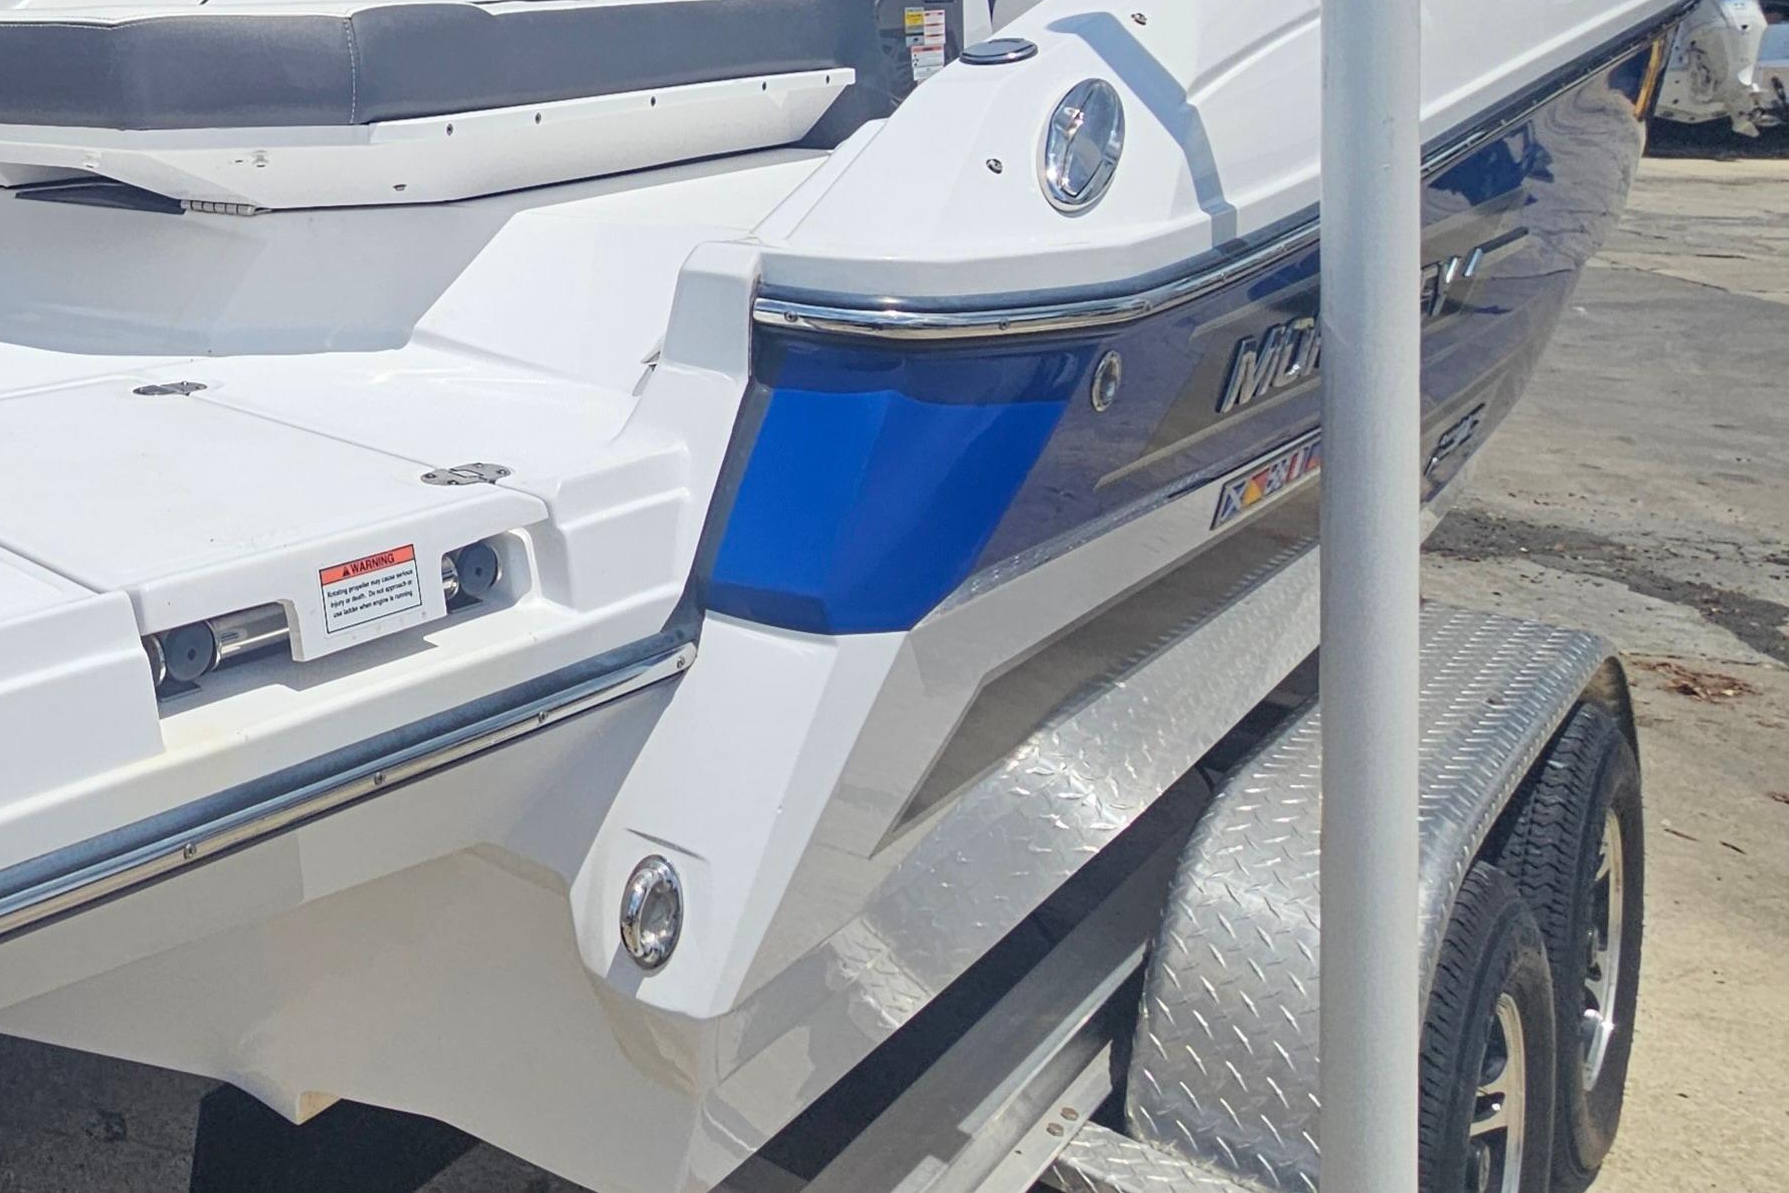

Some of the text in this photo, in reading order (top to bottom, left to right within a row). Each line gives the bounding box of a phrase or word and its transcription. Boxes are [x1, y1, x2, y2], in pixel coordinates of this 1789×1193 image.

[350, 553, 395, 574] WARNING
[327, 588, 348, 598] Rotating
[348, 581, 369, 593] propeller
[370, 578, 381, 586] may
[381, 574, 395, 583] cause
[368, 589, 376, 597] Do
[385, 582, 407, 593] approach
[343, 606, 358, 615] ladder
[359, 602, 371, 610] when
[373, 597, 389, 606] engine
